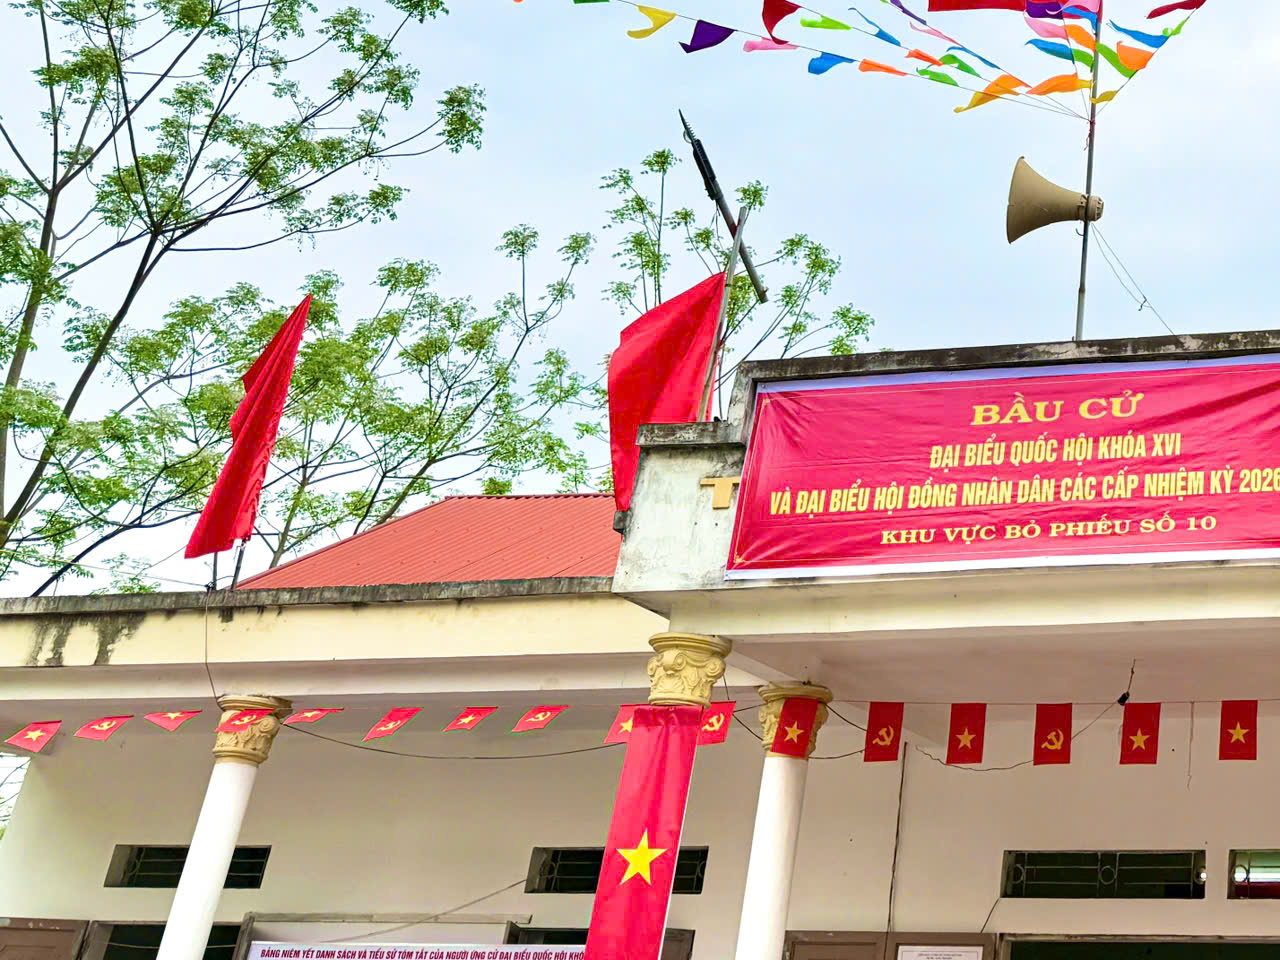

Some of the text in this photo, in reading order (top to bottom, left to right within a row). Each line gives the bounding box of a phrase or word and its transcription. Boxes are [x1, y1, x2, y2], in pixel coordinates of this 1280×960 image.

[970, 390, 1145, 426] BẦU CỬ
[929, 430, 1182, 473] ĐẠI BIỂU QUỐC HỘI KHÓA XVI
[770, 486, 791, 515] VÀ
[795, 489, 826, 519] ĐẠI
[829, 479, 870, 513] BIỂU
[873, 481, 904, 515] HỘI
[907, 476, 957, 509] ĐỒNG
[961, 477, 1013, 506] NHÂN
[1016, 474, 1055, 504] DÂN
[1060, 472, 1097, 501] CÁC
[1102, 466, 1138, 499] CẤP
[1143, 467, 1204, 501] NHIỆM
[1210, 464, 1234, 495] KỲ
[880, 511, 1217, 544] KHU VỰC BỎ PHIẾU SỐ 10
[260, 947, 280, 958] BẢNG
[316, 949, 336, 959] DANH
[337, 948, 356, 959] SÁCH
[357, 948, 368, 959] VÀ
[429, 948, 444, 960] CỦA
